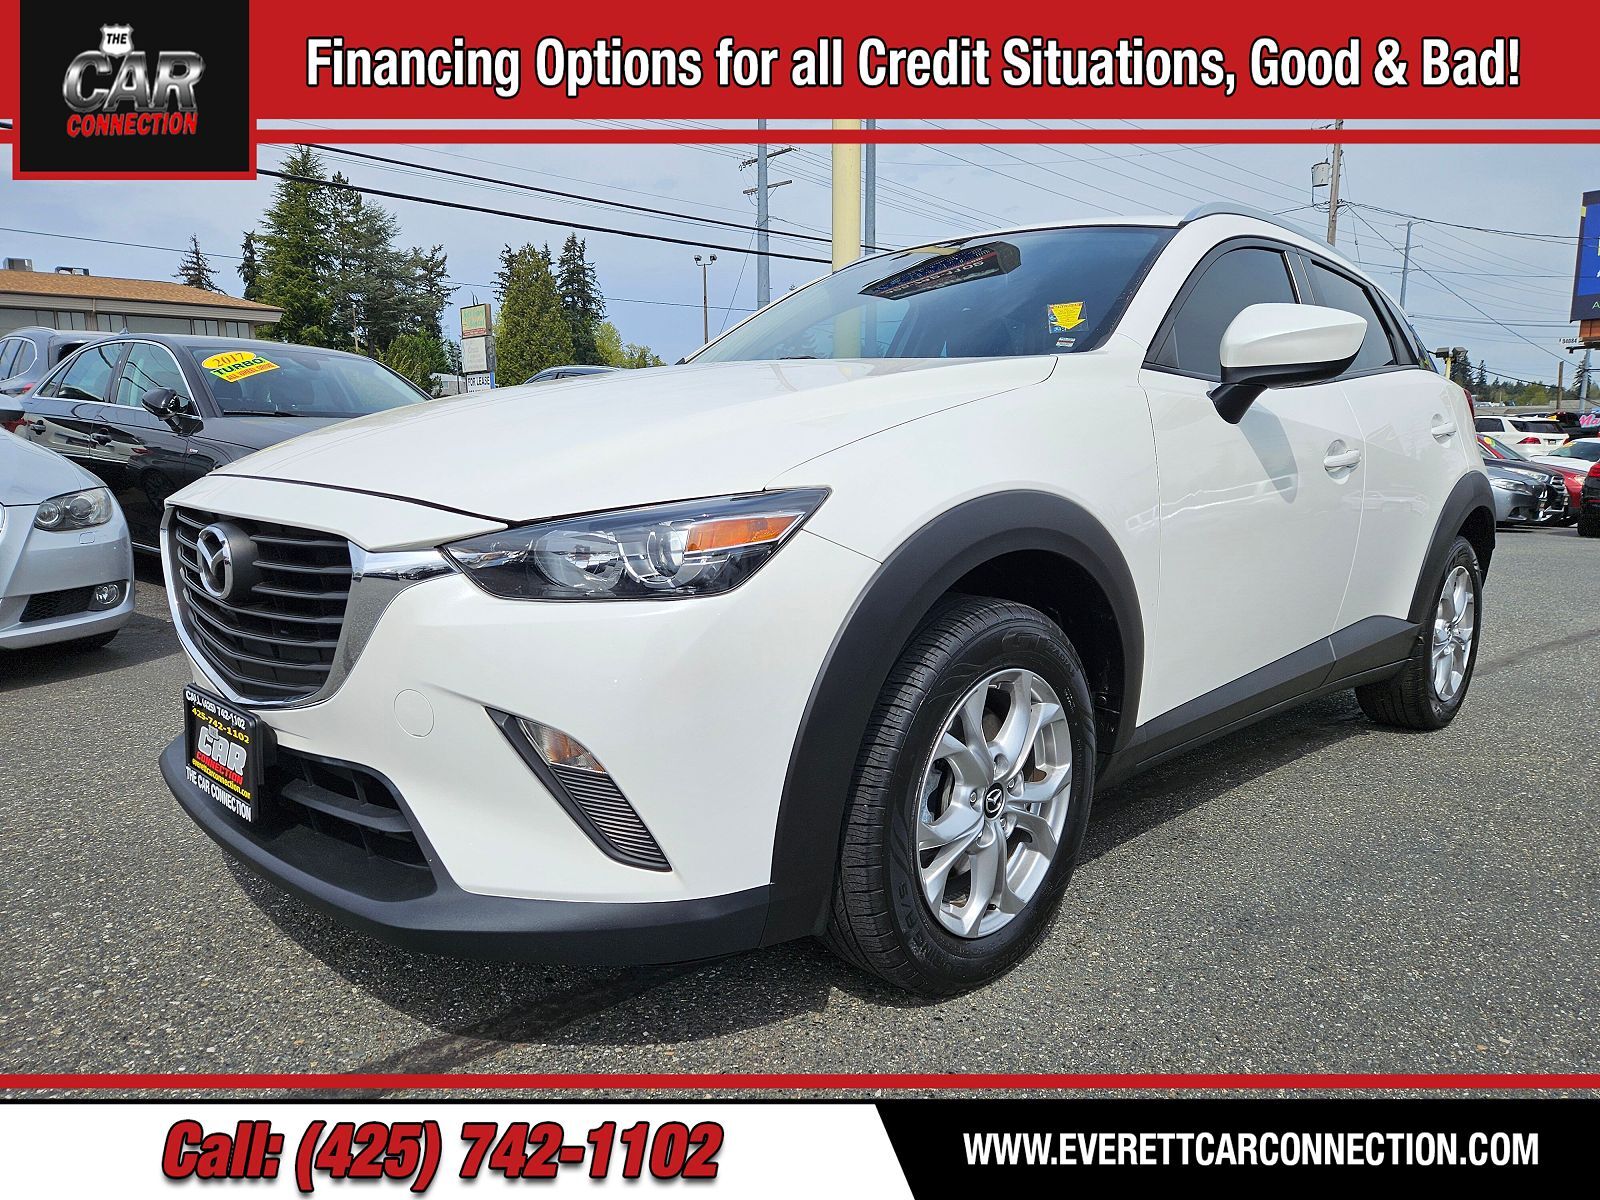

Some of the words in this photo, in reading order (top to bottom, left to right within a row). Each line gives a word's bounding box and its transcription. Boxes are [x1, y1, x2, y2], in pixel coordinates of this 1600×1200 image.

[213, 353, 244, 367] 2017
[214, 358, 264, 375] TURBO
[468, 377, 476, 387] FOR
[476, 375, 490, 387] LEASE
[192, 707, 250, 744] 425-742-1102
[217, 706, 246, 730] 742-1102
[198, 725, 247, 776] CAR
[195, 751, 244, 785] CONNECTION
[186, 766, 197, 785] THE
[198, 774, 211, 795] CAR
[210, 783, 252, 822] CONNECTION
